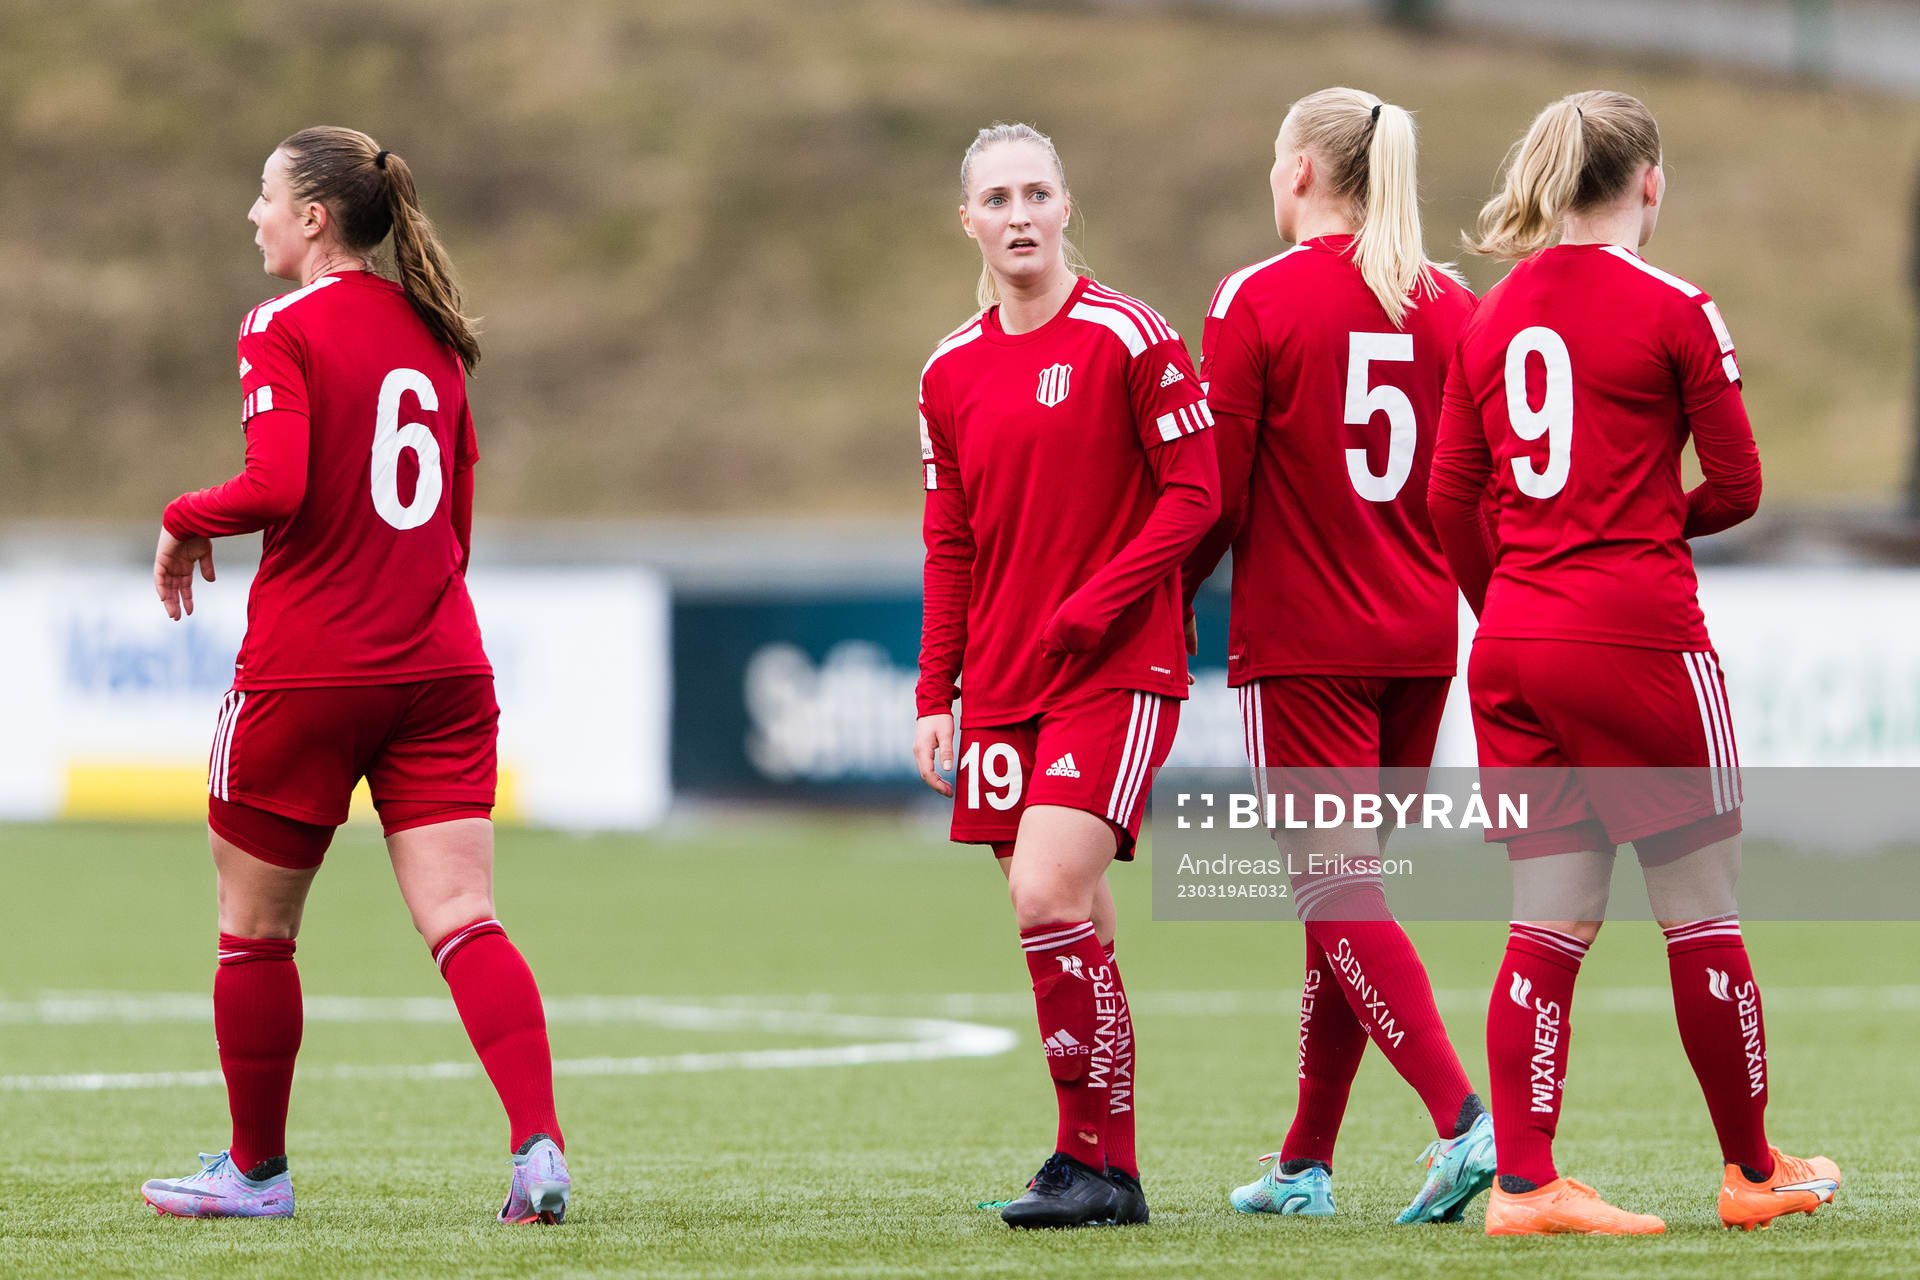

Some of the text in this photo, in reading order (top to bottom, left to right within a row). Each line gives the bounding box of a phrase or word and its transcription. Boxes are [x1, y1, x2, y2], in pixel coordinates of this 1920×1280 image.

[371, 368, 443, 530] 6
[1344, 331, 1417, 502] 5
[1505, 326, 1574, 499] 9
[960, 742, 1023, 811] 19
[1045, 766, 1081, 779] adidas
[1088, 964, 1117, 1089] WIXNERS
[1333, 937, 1405, 1049] WIXNERS
[1734, 980, 1765, 1098] WIXNERS
[1530, 997, 1561, 1114] WIXNERS
